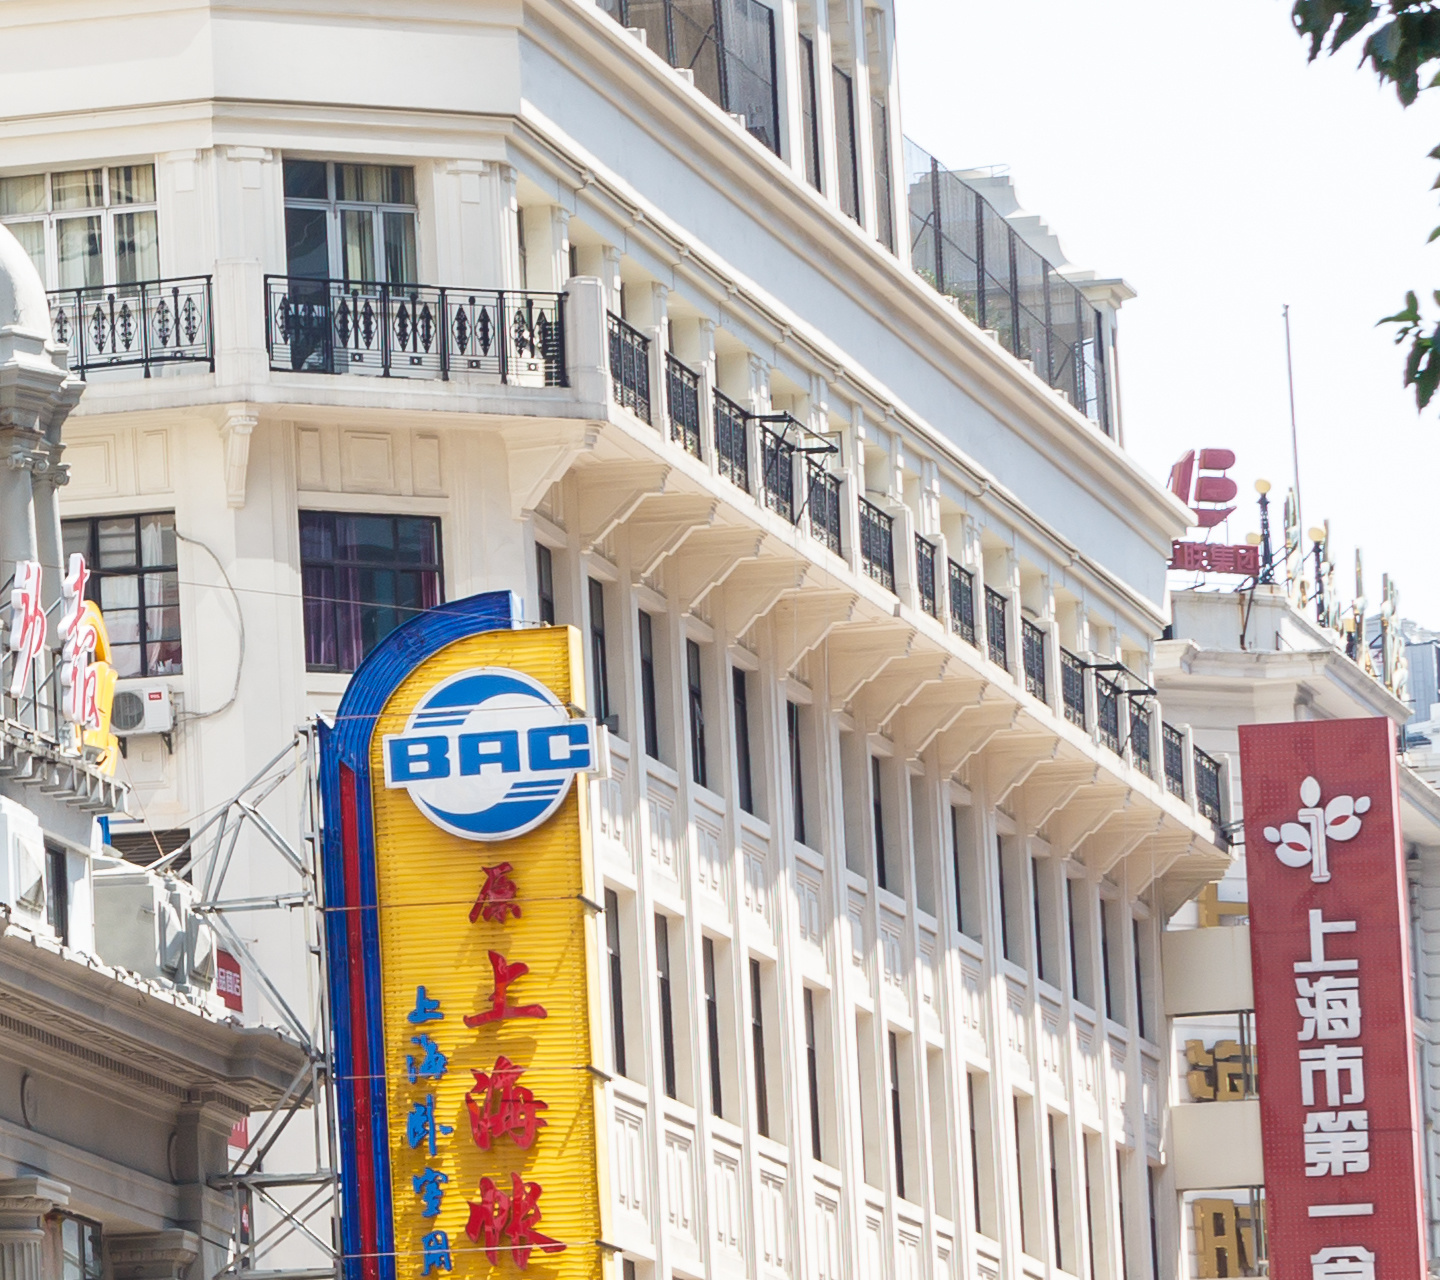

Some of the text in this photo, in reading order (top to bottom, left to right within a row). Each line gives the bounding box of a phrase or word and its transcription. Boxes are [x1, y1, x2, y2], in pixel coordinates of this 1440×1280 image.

[1173, 542, 1259, 573] 联集团
[389, 723, 590, 782] BAC
